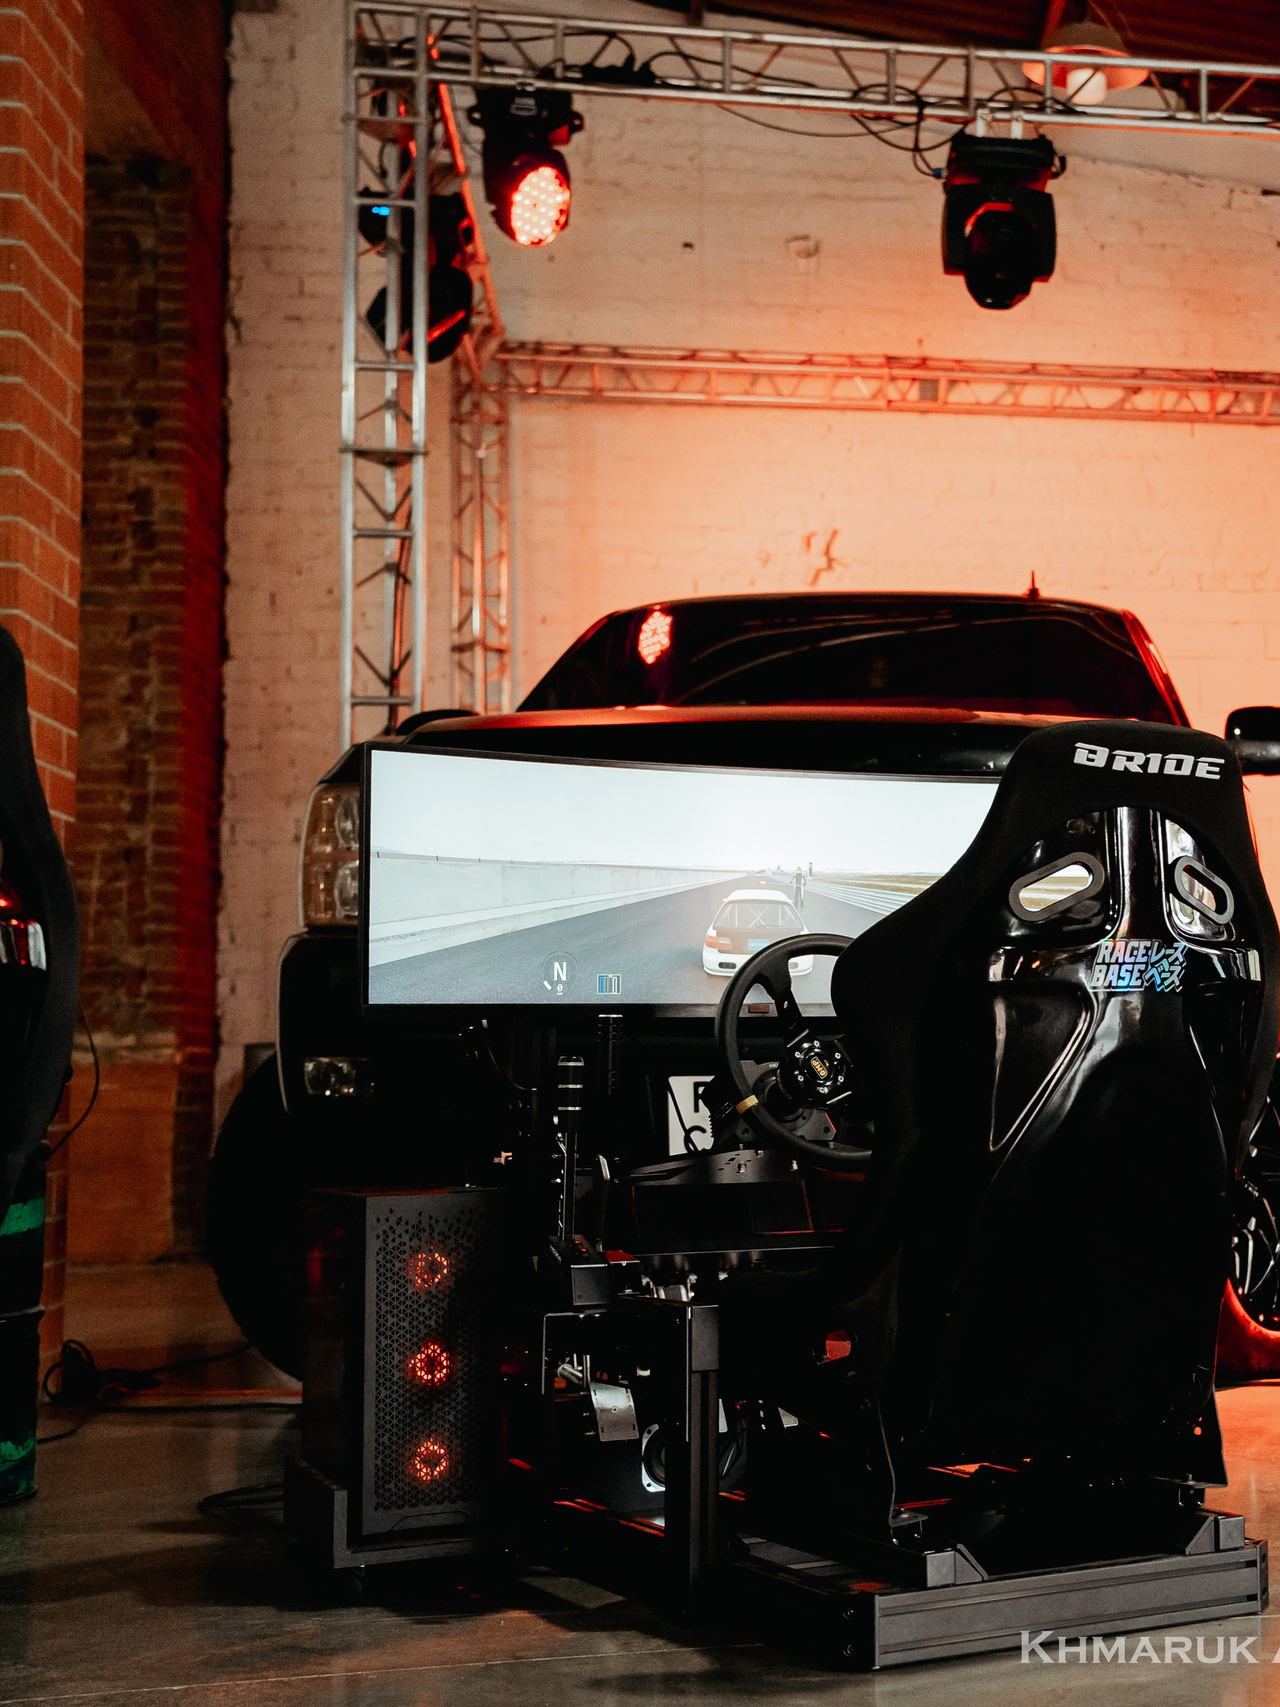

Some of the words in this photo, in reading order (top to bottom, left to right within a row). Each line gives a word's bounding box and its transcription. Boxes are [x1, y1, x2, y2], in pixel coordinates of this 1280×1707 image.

[1073, 742, 1225, 780] BRIDE
[1097, 940, 1151, 963] RACE
[553, 962, 567, 981] N
[1090, 964, 1146, 986] BASE
[811, 1059, 827, 1077] OMP
